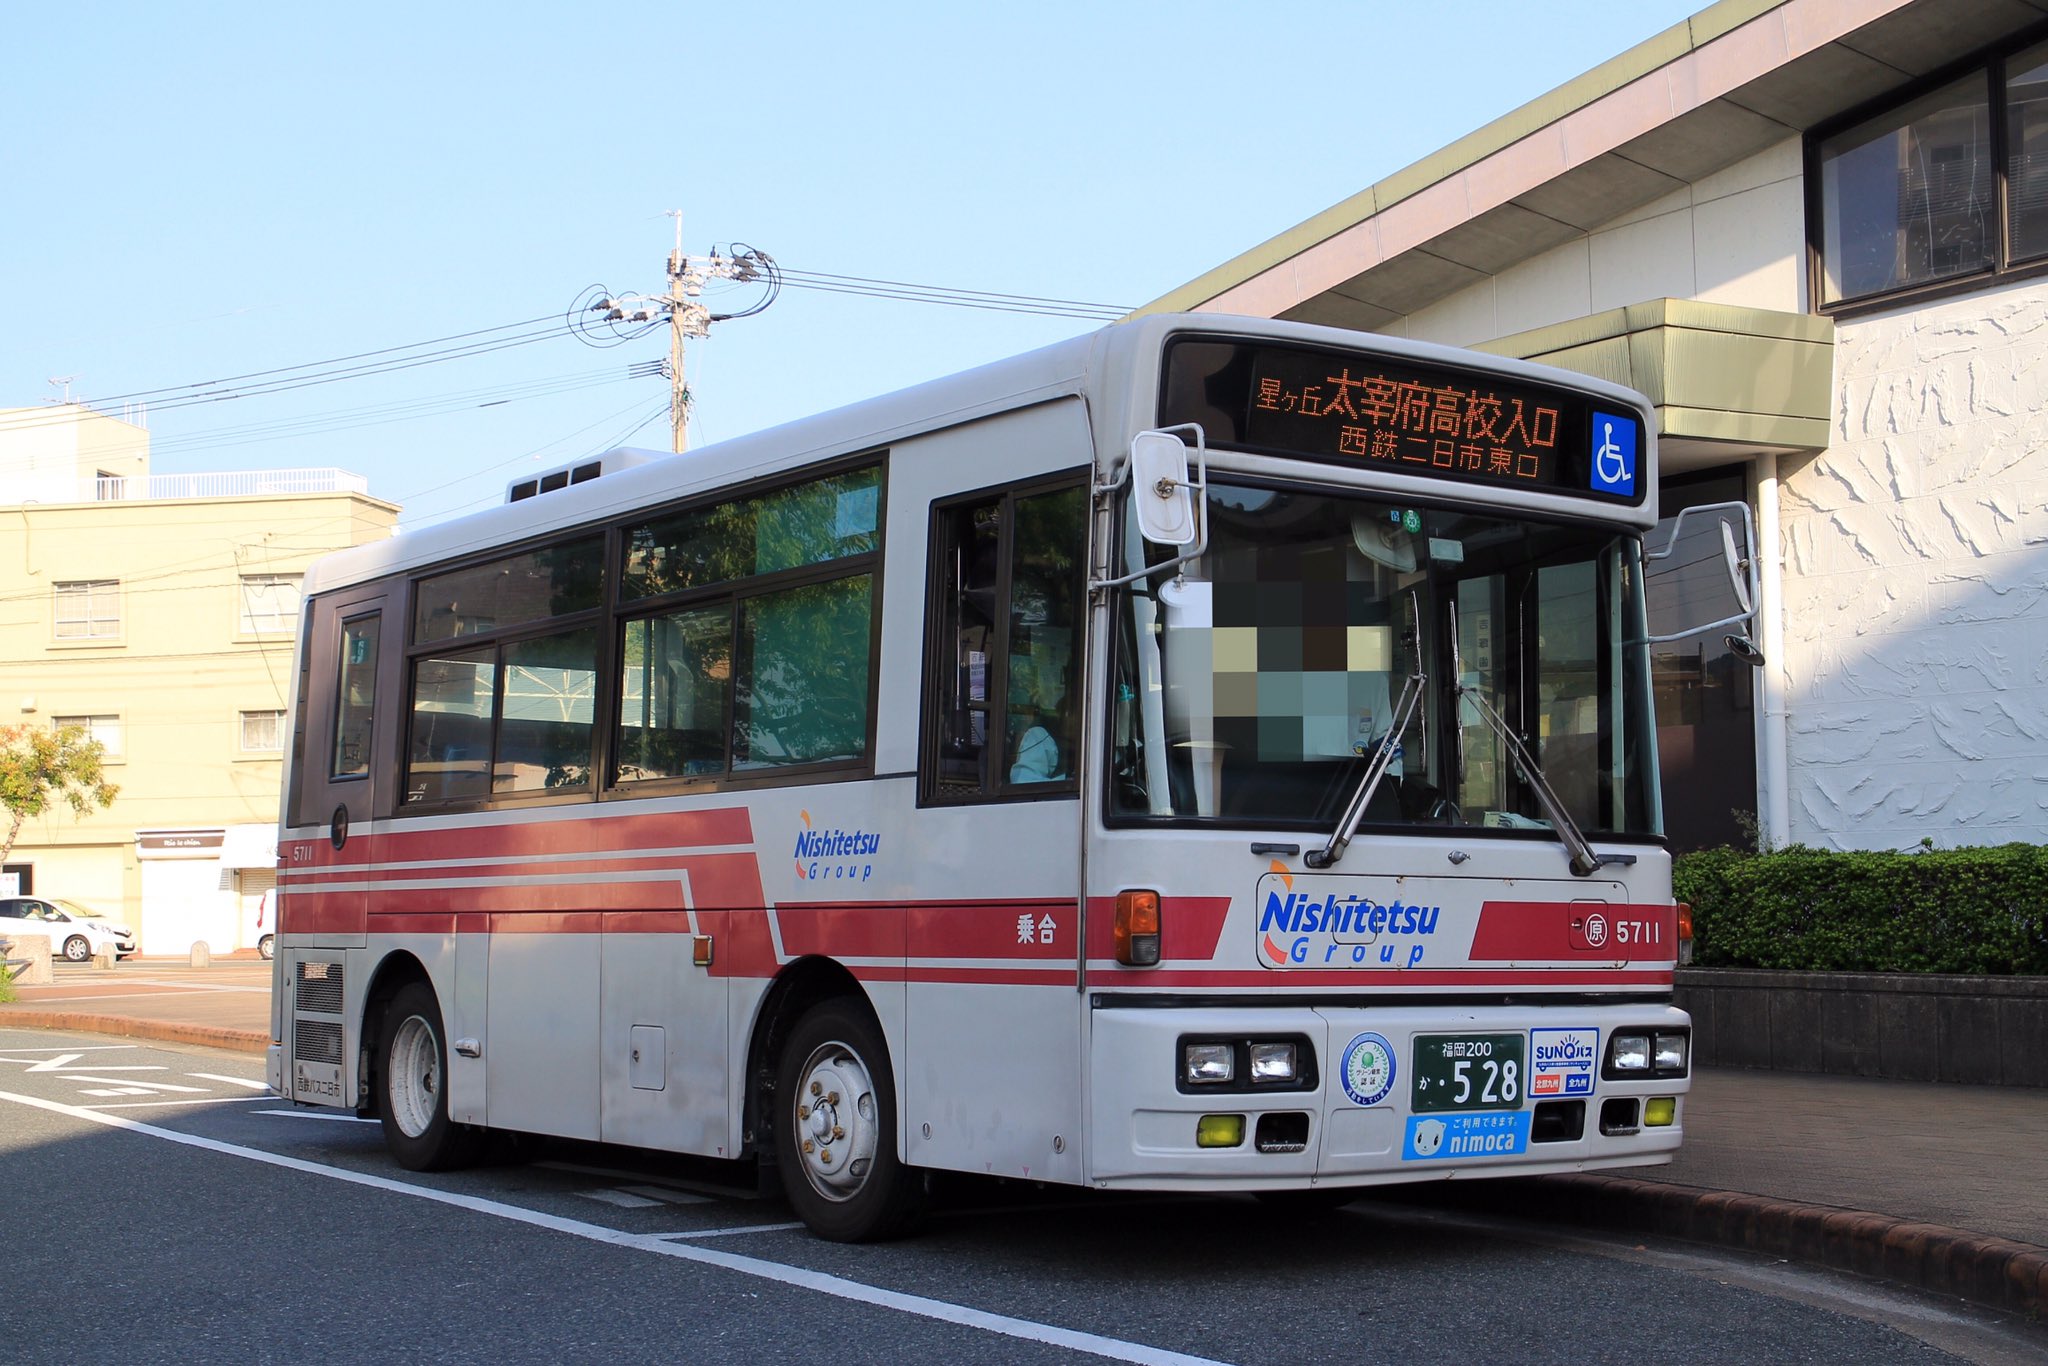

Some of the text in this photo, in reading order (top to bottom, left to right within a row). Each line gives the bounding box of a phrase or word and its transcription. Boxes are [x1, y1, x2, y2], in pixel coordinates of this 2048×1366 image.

[1322, 368, 1558, 447] 太宰府高校入口
[1340, 425, 1538, 478] 西鉄二日市東口
[294, 846, 312, 861] 5711
[794, 830, 880, 858] Nishitetsu
[809, 862, 872, 882] Group
[1259, 891, 1440, 934] Nishitetsu
[1016, 913, 1057, 944] 乗合
[1588, 918, 1605, 942] 原
[1617, 921, 1659, 944] 5711
[1291, 936, 1424, 969] Group
[1450, 1130, 1515, 1153] nimoca
